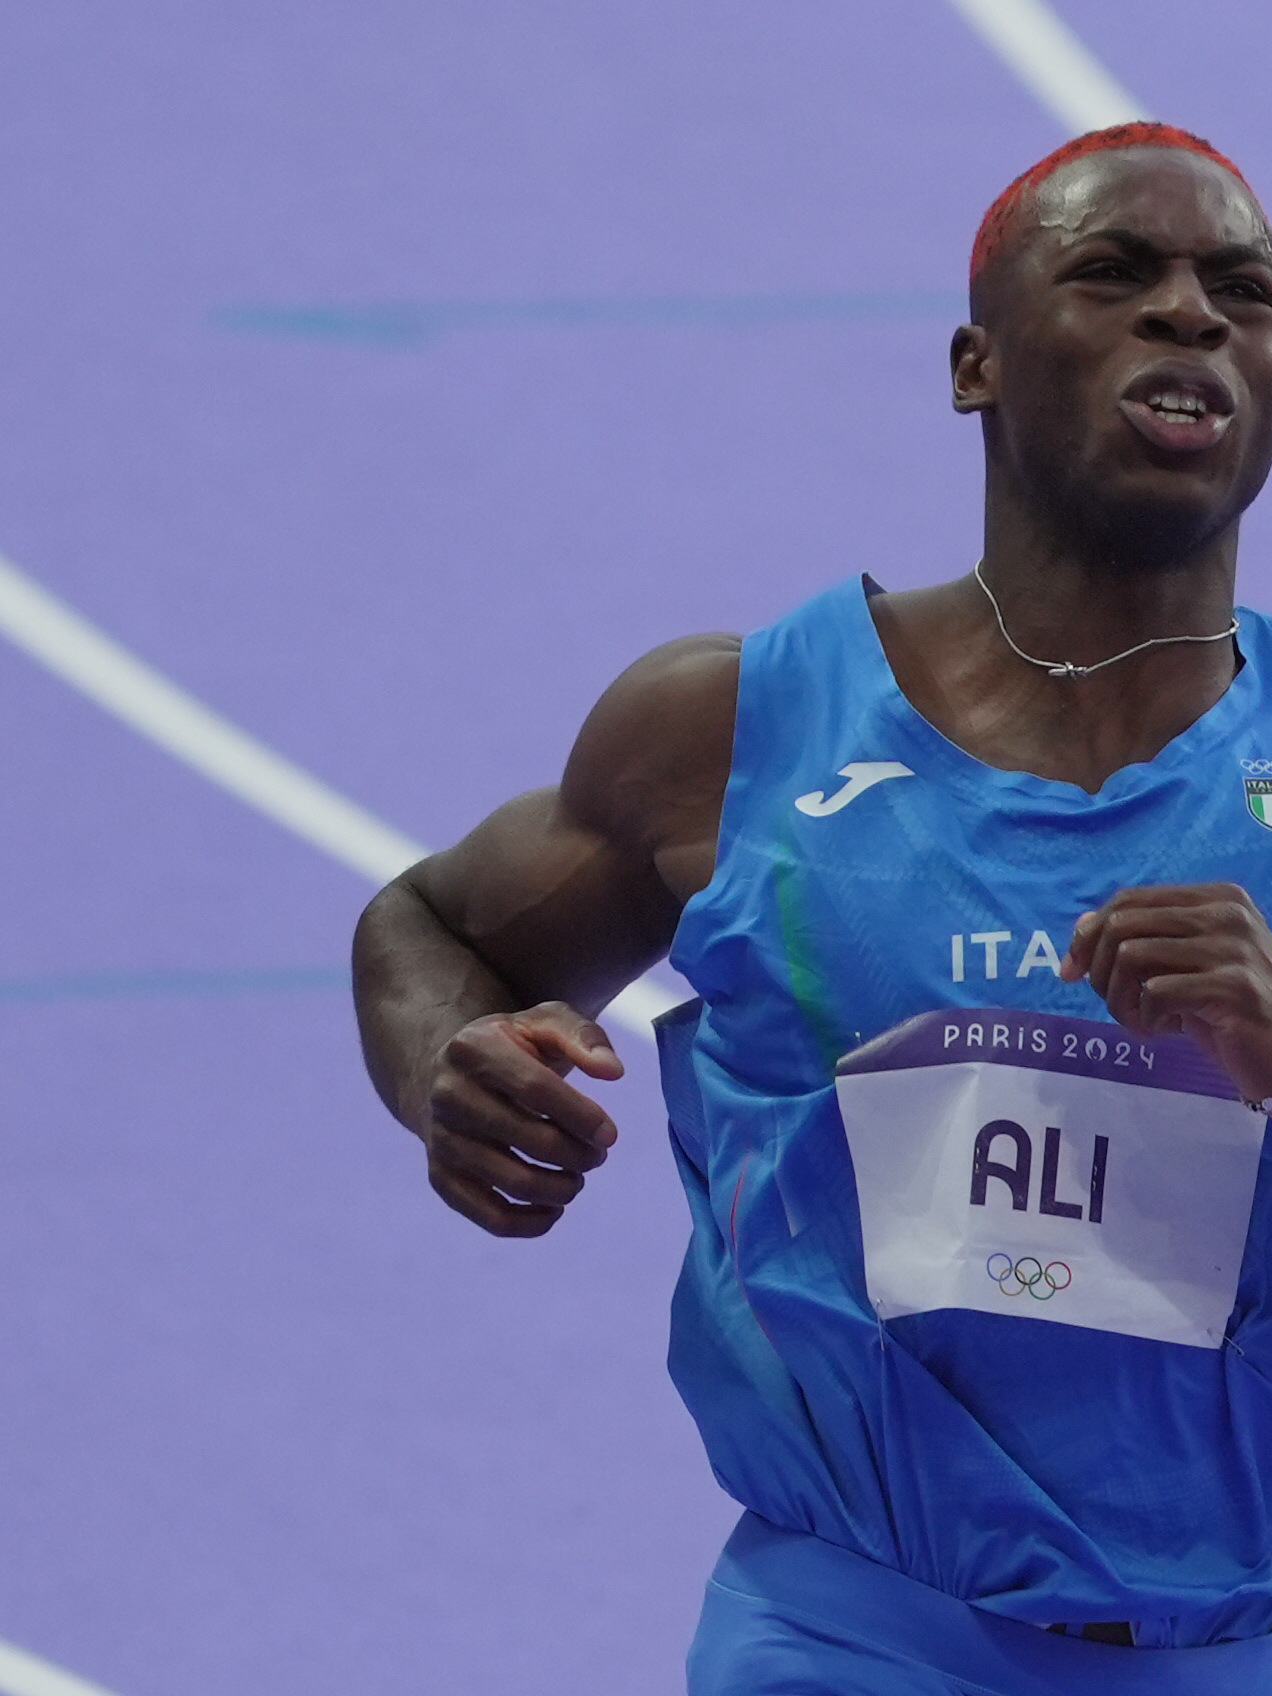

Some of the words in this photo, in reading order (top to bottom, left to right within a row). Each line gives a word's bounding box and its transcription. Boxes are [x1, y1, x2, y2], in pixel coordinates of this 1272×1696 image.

[952, 930, 1090, 983] ITA
[1062, 1033, 1154, 1070] 2024
[969, 1119, 1109, 1224] ALI
